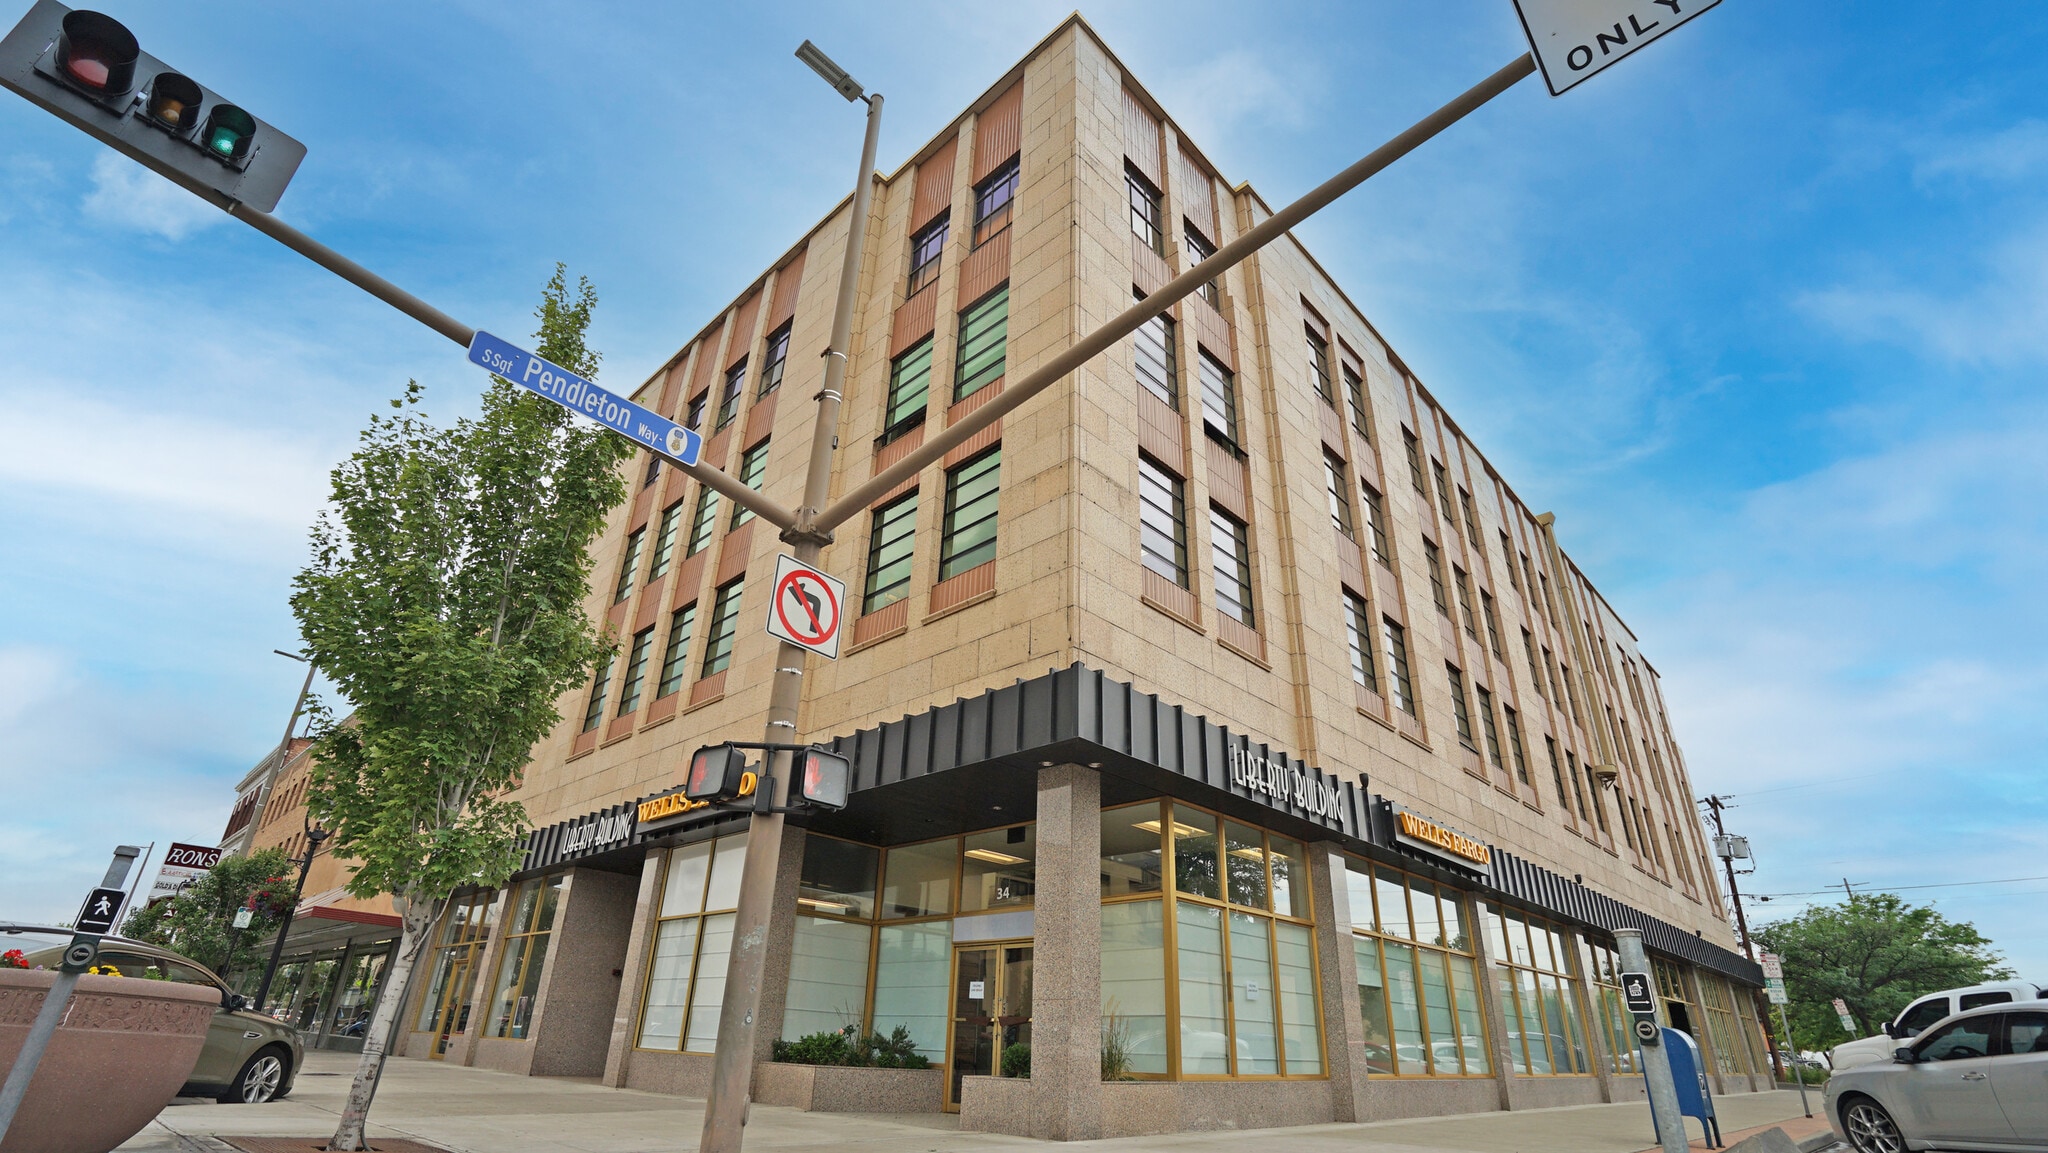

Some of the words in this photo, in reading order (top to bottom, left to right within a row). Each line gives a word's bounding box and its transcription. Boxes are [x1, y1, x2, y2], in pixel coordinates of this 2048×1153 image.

[522, 357, 632, 429] Pendleton
[637, 422, 659, 445] Way
[1233, 743, 1289, 802] LIBERTY
[1294, 767, 1344, 823] BUILDING
[638, 791, 691, 822] WELLS
[563, 822, 597, 854] LIBERTY
[595, 811, 634, 846] BUILDING
[1400, 811, 1451, 849] WELLS
[1451, 831, 1490, 865] FARGO
[167, 848, 219, 868] RON'S
[996, 887, 1010, 899] 34
